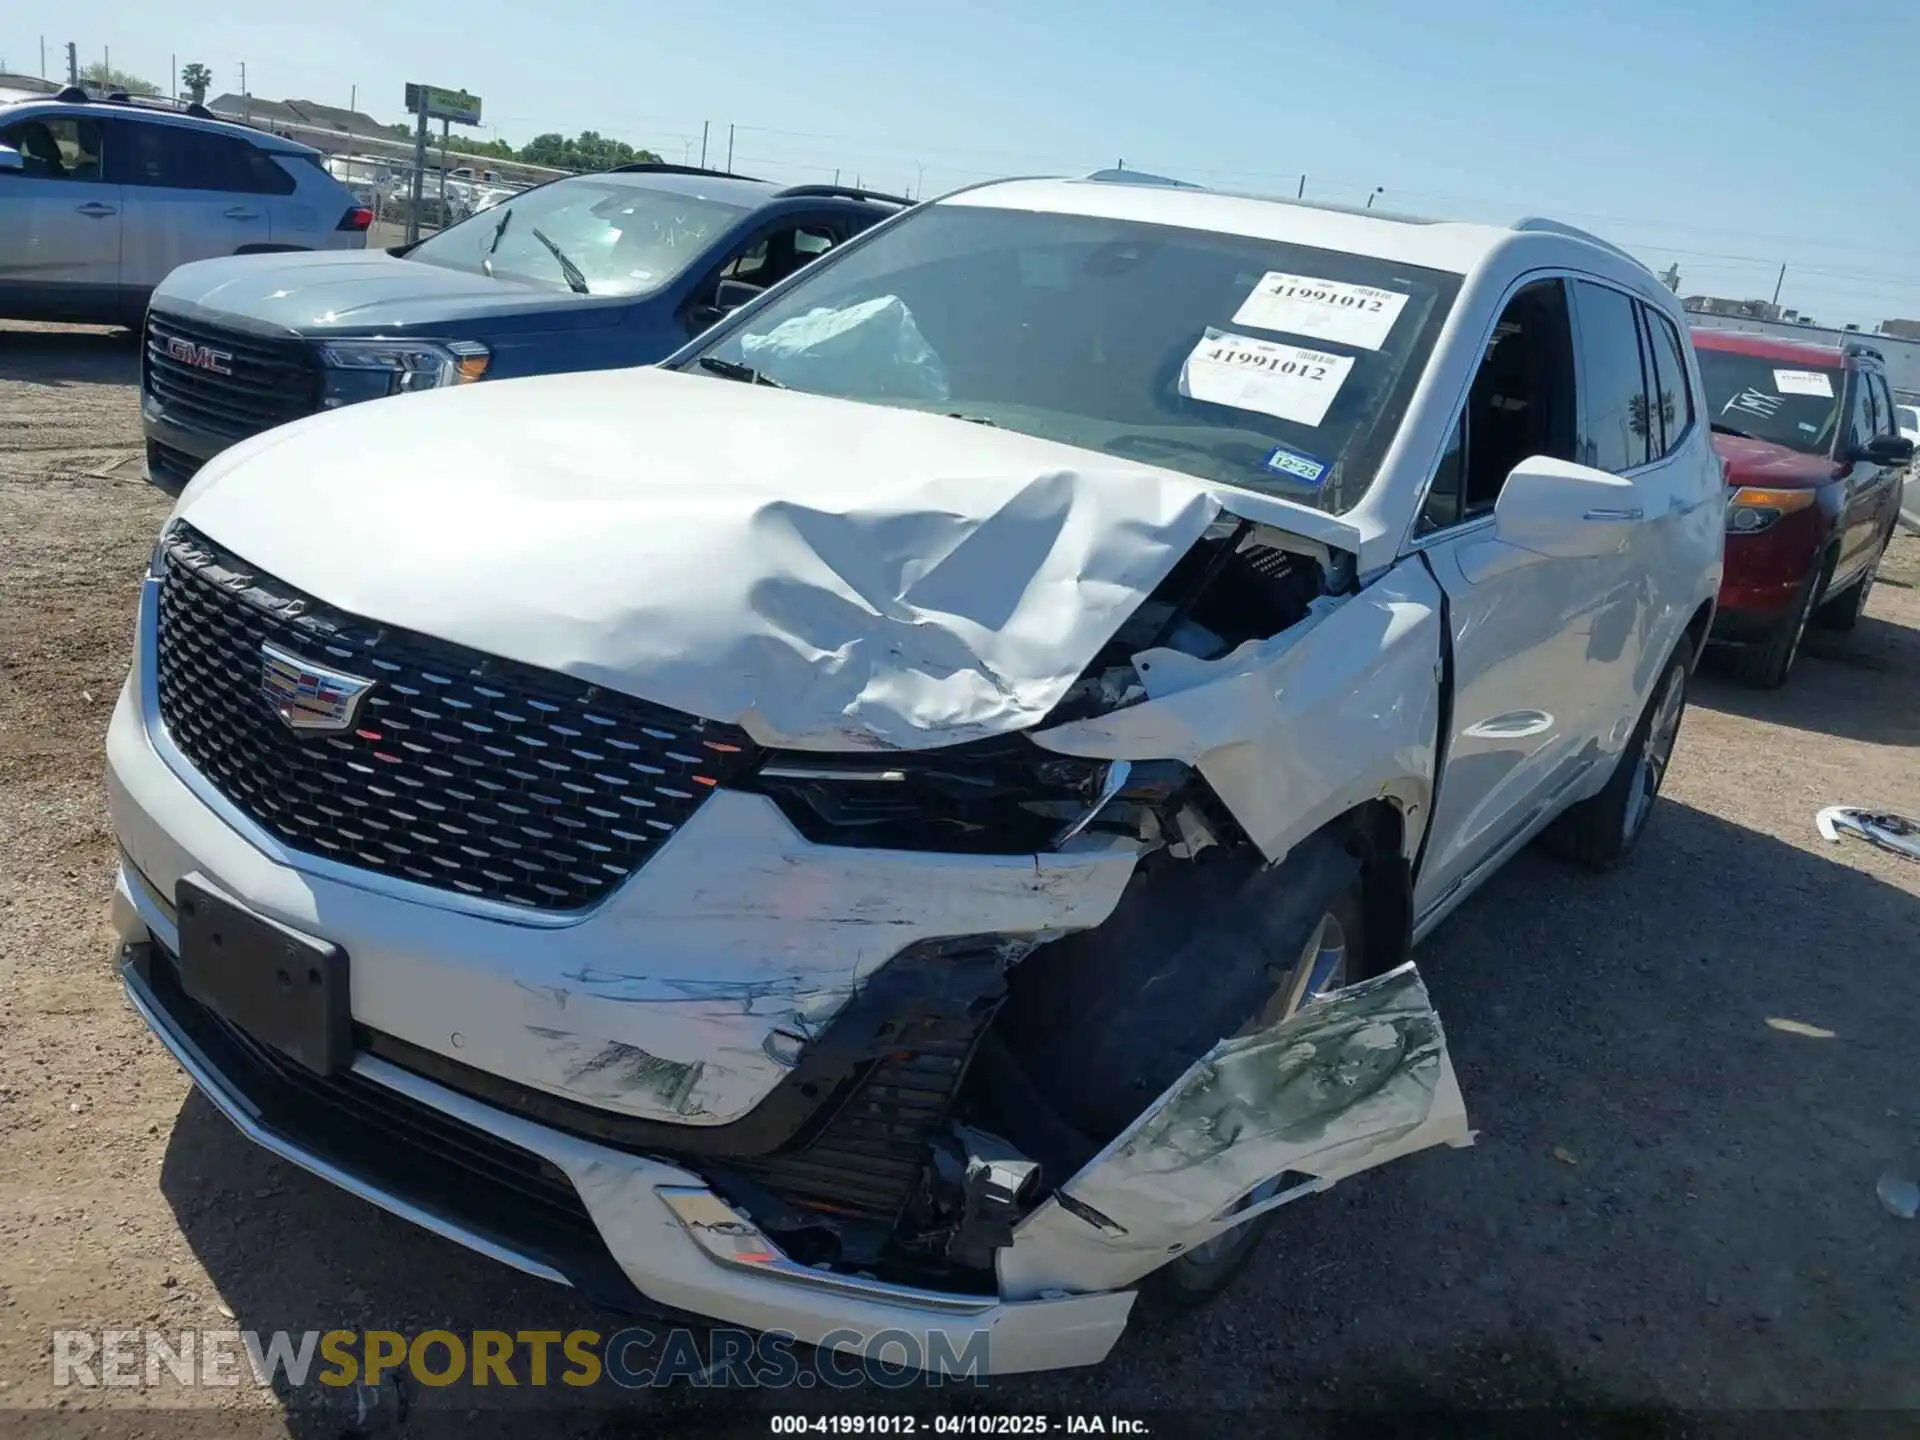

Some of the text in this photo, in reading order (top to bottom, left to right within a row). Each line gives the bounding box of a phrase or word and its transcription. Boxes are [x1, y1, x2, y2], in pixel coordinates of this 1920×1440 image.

[1269, 284, 1383, 313] 41991012
[168, 336, 233, 376] GMC
[1208, 348, 1327, 381] 41991012
